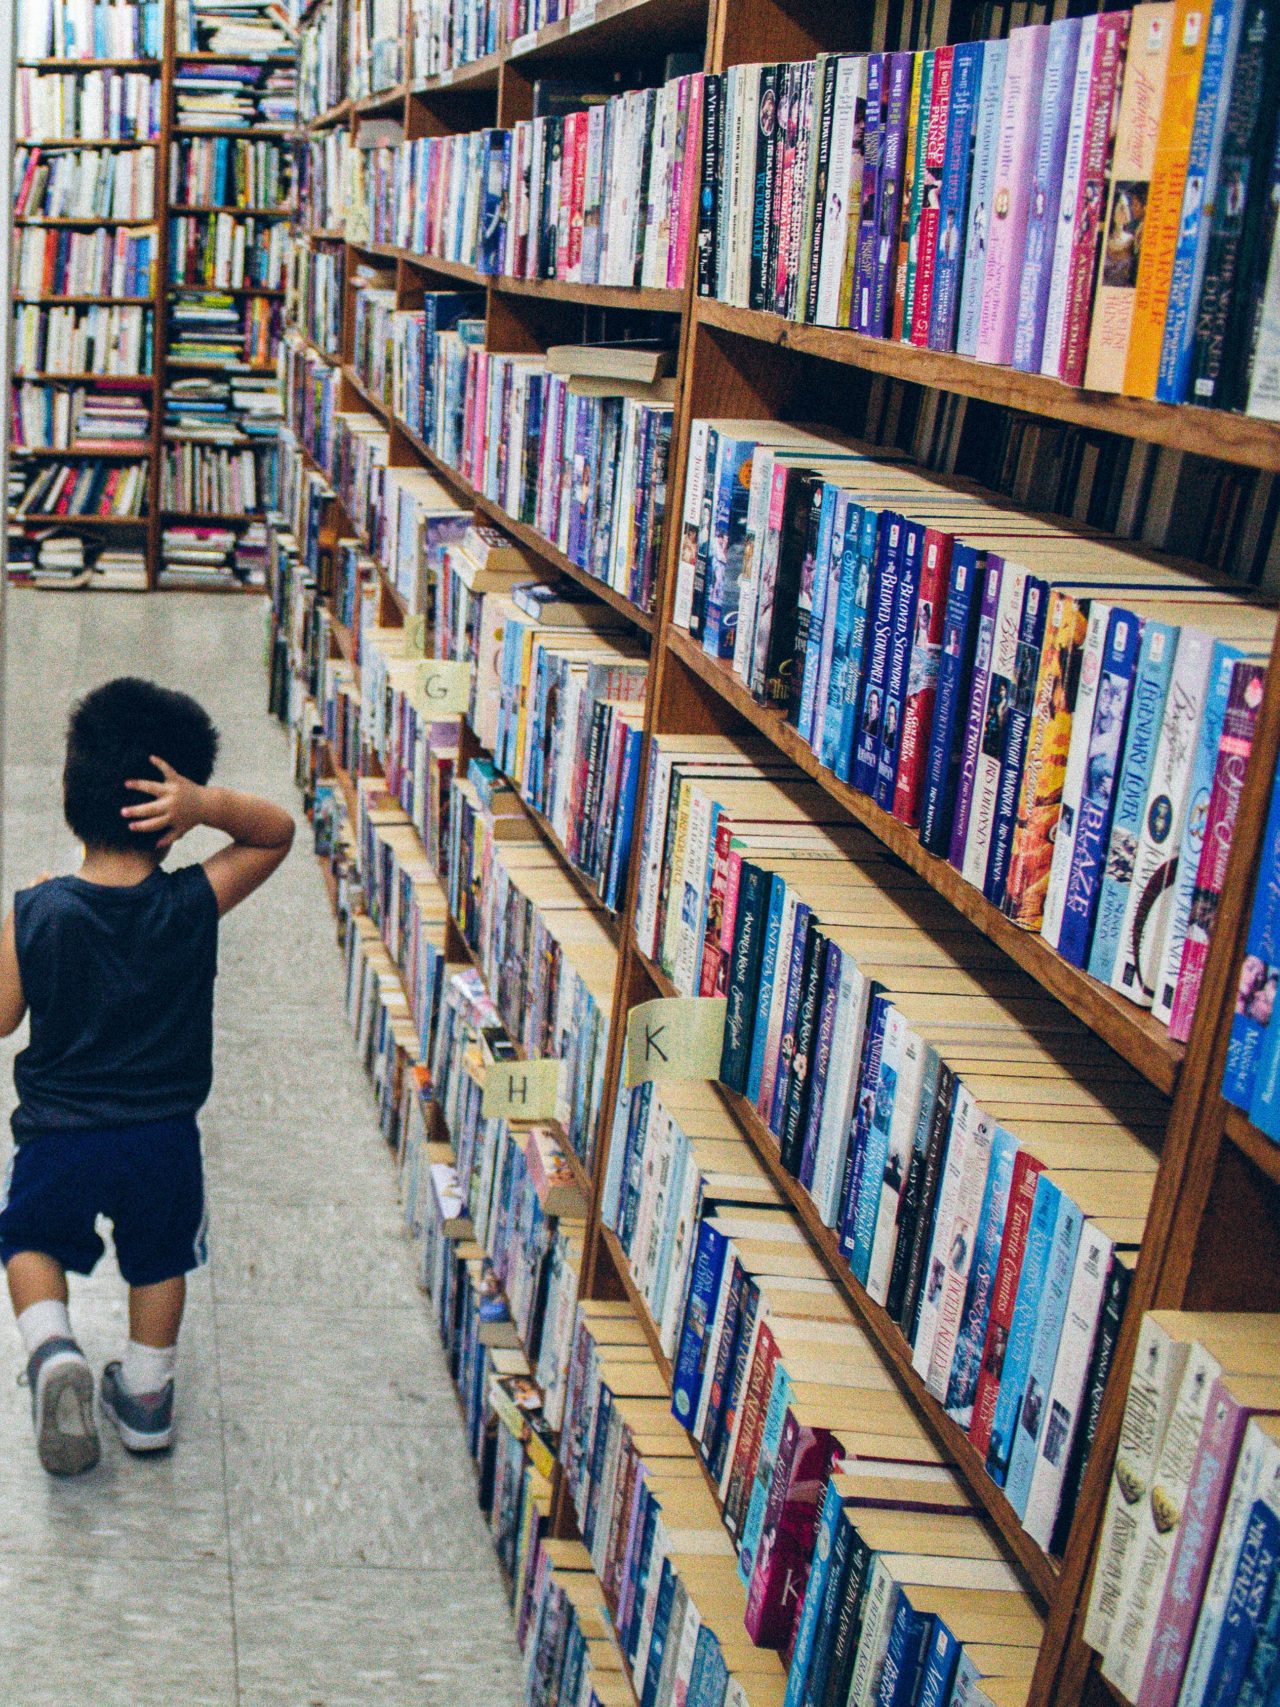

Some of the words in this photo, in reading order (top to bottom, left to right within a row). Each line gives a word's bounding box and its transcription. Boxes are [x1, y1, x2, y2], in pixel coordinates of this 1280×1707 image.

[823, 81, 834, 115] SUSAN
[706, 95, 718, 150] VICTORIA
[819, 116, 831, 163] HOWATCH
[927, 106, 940, 160] PRINCE
[936, 97, 950, 164] LEOPARD
[705, 152, 715, 182] HOLT
[890, 133, 900, 169] HANNAH
[754, 172, 766, 226] VICTORIA
[780, 167, 792, 226] VICTORIA
[978, 170, 989, 197] HOYT
[815, 203, 823, 221] THE
[752, 229, 762, 258] HOLT
[778, 229, 789, 255] HOLT
[811, 222, 823, 273] SHROUDED
[924, 213, 935, 278] ELIZABETH
[1150, 205, 1178, 326] CHARMER
[761, 251, 769, 289] ISLAND
[809, 274, 818, 305] WALLS
[920, 284, 929, 317] HOYT
[1101, 297, 1120, 347] HUNTER
[1197, 275, 1219, 341] DUKE
[1068, 323, 1080, 369] DUKE
[1208, 287, 1234, 378] WICKED
[423, 672, 449, 700] G
[937, 673, 955, 743] MAGNIFICENT
[901, 707, 914, 763] BARBARIAN
[908, 716, 920, 757] GOLDEN
[1007, 713, 1027, 767] MIDNIGHT
[1130, 674, 1162, 770] LEGENDARY
[962, 725, 980, 781] PRINCE
[985, 759, 999, 785] IRIS
[929, 786, 938, 804] IRIS
[999, 769, 1019, 818] WARRIOR
[1120, 771, 1148, 823] LOVER
[676, 811, 689, 854] BRENDA
[923, 804, 936, 844] JOHANSEN
[976, 786, 997, 849] JOHANSEN
[998, 823, 1010, 841] IRIS
[672, 853, 685, 887] JOYCE
[1074, 807, 1105, 918] BLAZE
[737, 912, 755, 954] ANDREA
[761, 914, 780, 976] ANDREA
[737, 954, 749, 984] KANE
[759, 980, 773, 1020] KANE
[800, 967, 818, 1022] ANDREA
[819, 987, 836, 1041] ANDREA
[644, 1023, 670, 1064] K
[799, 1021, 812, 1057] KANE
[817, 1042, 830, 1079] KANE
[507, 1074, 528, 1105] H
[792, 1078, 802, 1101] THE
[785, 1105, 801, 1143] THEFT
[916, 1100, 929, 1152] STACEY
[930, 1112, 943, 1158] STACEY
[876, 1145, 886, 1165] THE
[870, 1166, 883, 1202] ROYAL
[906, 1158, 920, 1206] KAYNE
[922, 1164, 935, 1207] KAYNE
[862, 1202, 877, 1250] HUNTER
[1007, 1203, 1028, 1258] Favorite
[725, 1289, 739, 1319] LISA
[942, 1272, 966, 1324] JOCELYN
[997, 1257, 1019, 1316] Countess
[714, 1321, 733, 1381] KLEYPAS
[741, 1311, 756, 1344] LISA
[933, 1325, 956, 1372] KELLEY
[730, 1346, 749, 1407] KLEYPAS
[749, 1354, 766, 1388] LISA
[1097, 1330, 1113, 1378] JENNA
[739, 1389, 759, 1451] KLEYPAS
[978, 1383, 996, 1424] KELLY
[1086, 1382, 1106, 1443] KERNAN
[1120, 1377, 1159, 1455] MICHAELS
[781, 1568, 803, 1606] K
[1227, 1517, 1268, 1627] MICHAELS
[1245, 1550, 1273, 1620] KASEY
[863, 1601, 879, 1649] BETINA
[852, 1650, 867, 1703] KRAHN
